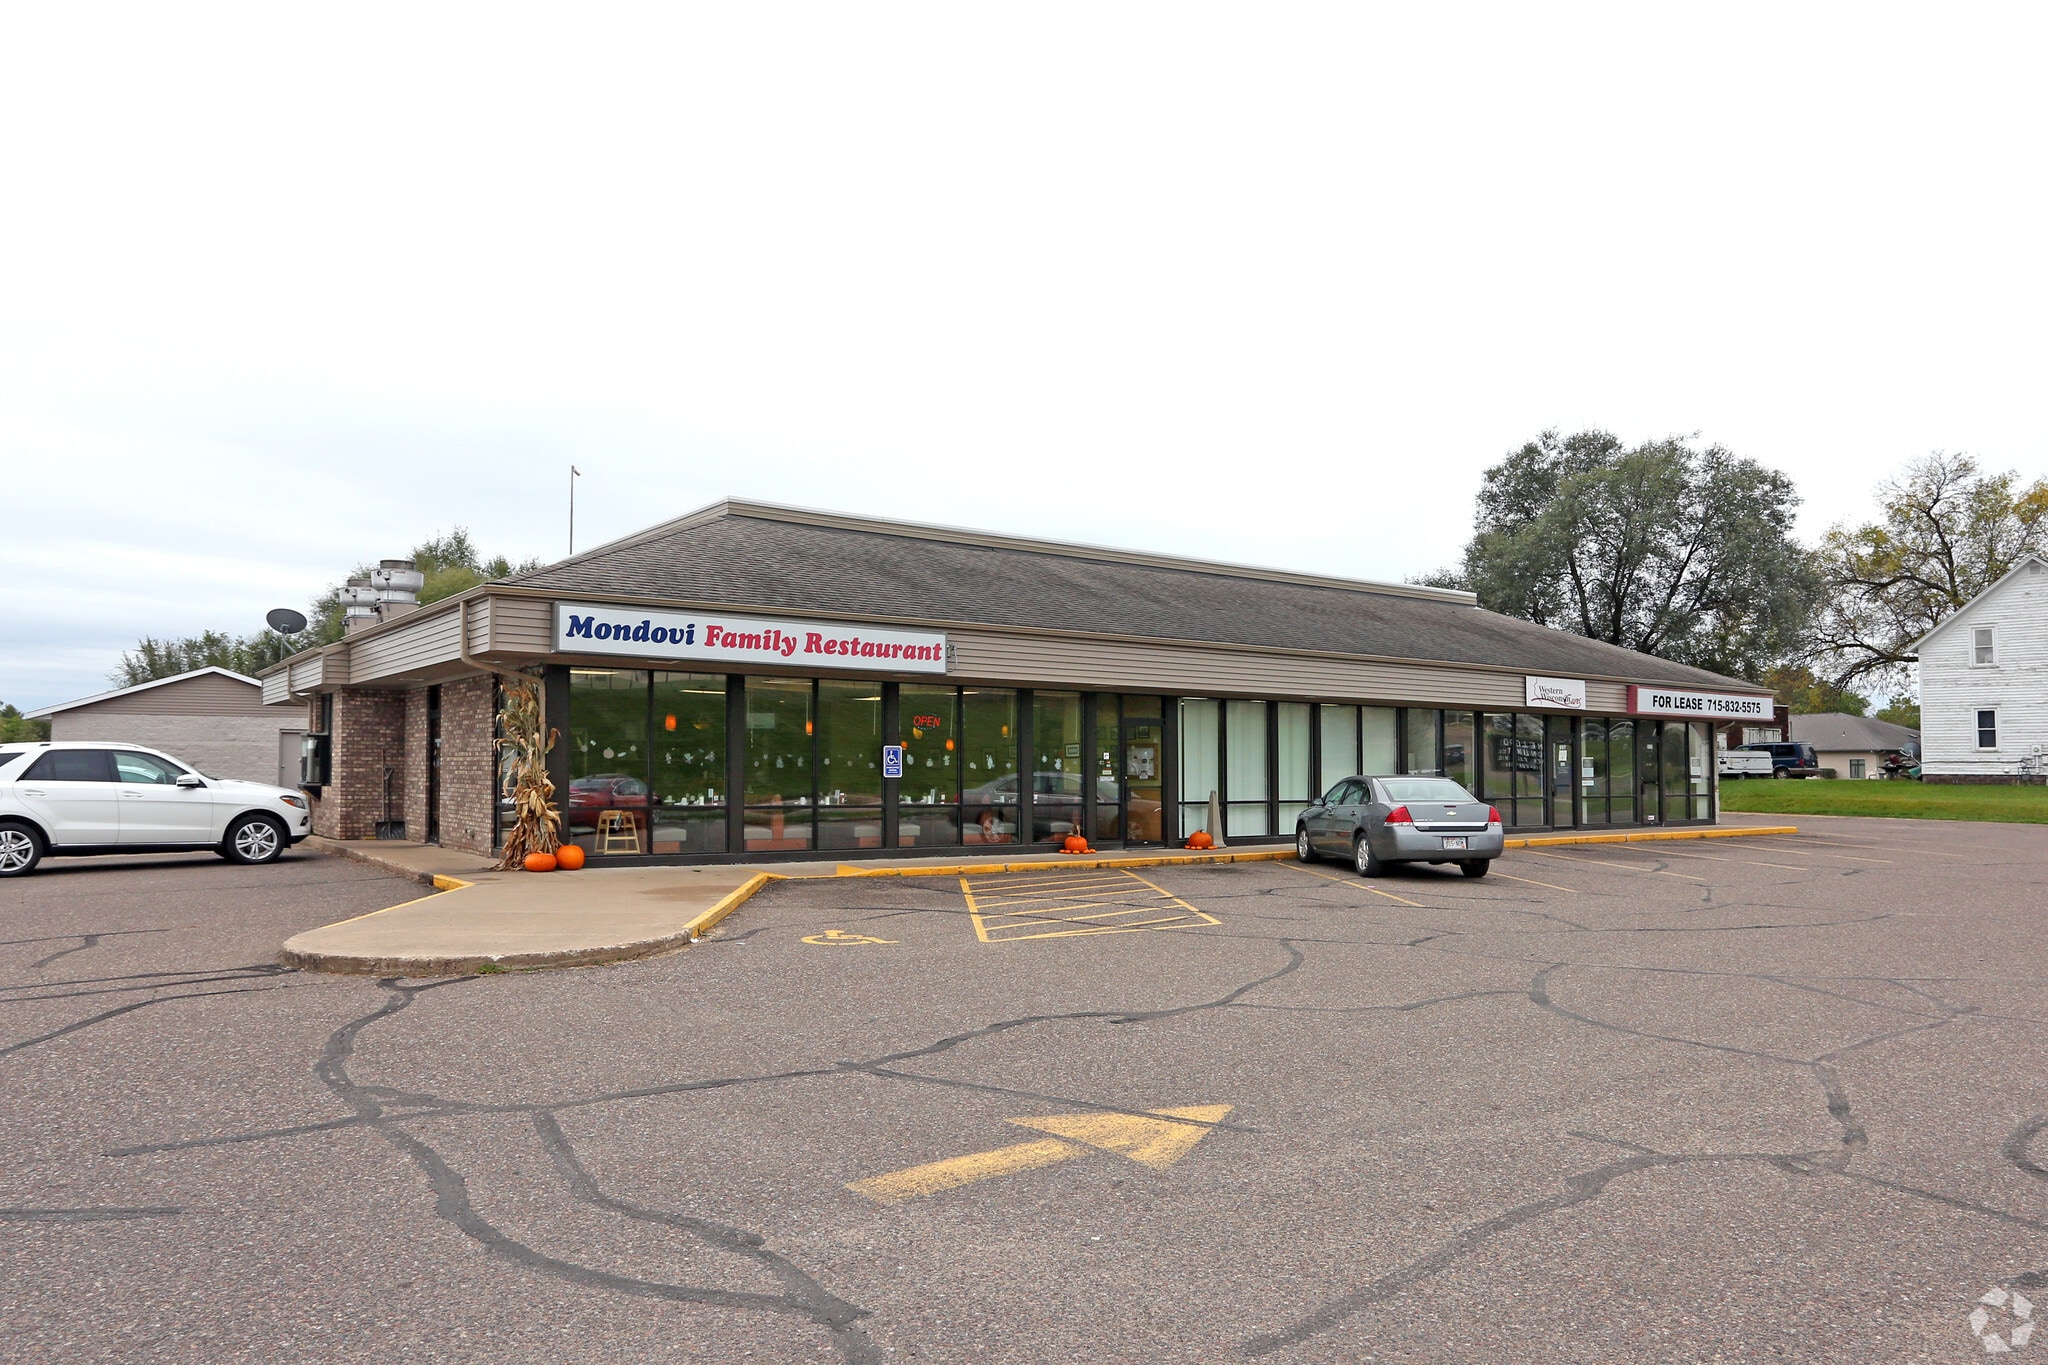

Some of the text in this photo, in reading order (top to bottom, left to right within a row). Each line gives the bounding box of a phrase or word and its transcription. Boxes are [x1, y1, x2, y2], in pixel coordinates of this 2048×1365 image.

[566, 614, 942, 661] Mondovi Family Restaurant
[1538, 685, 1563, 695] Western
[1653, 694, 1761, 714] FOR LEASE 715-832-5575
[913, 715, 941, 727] OPEN
